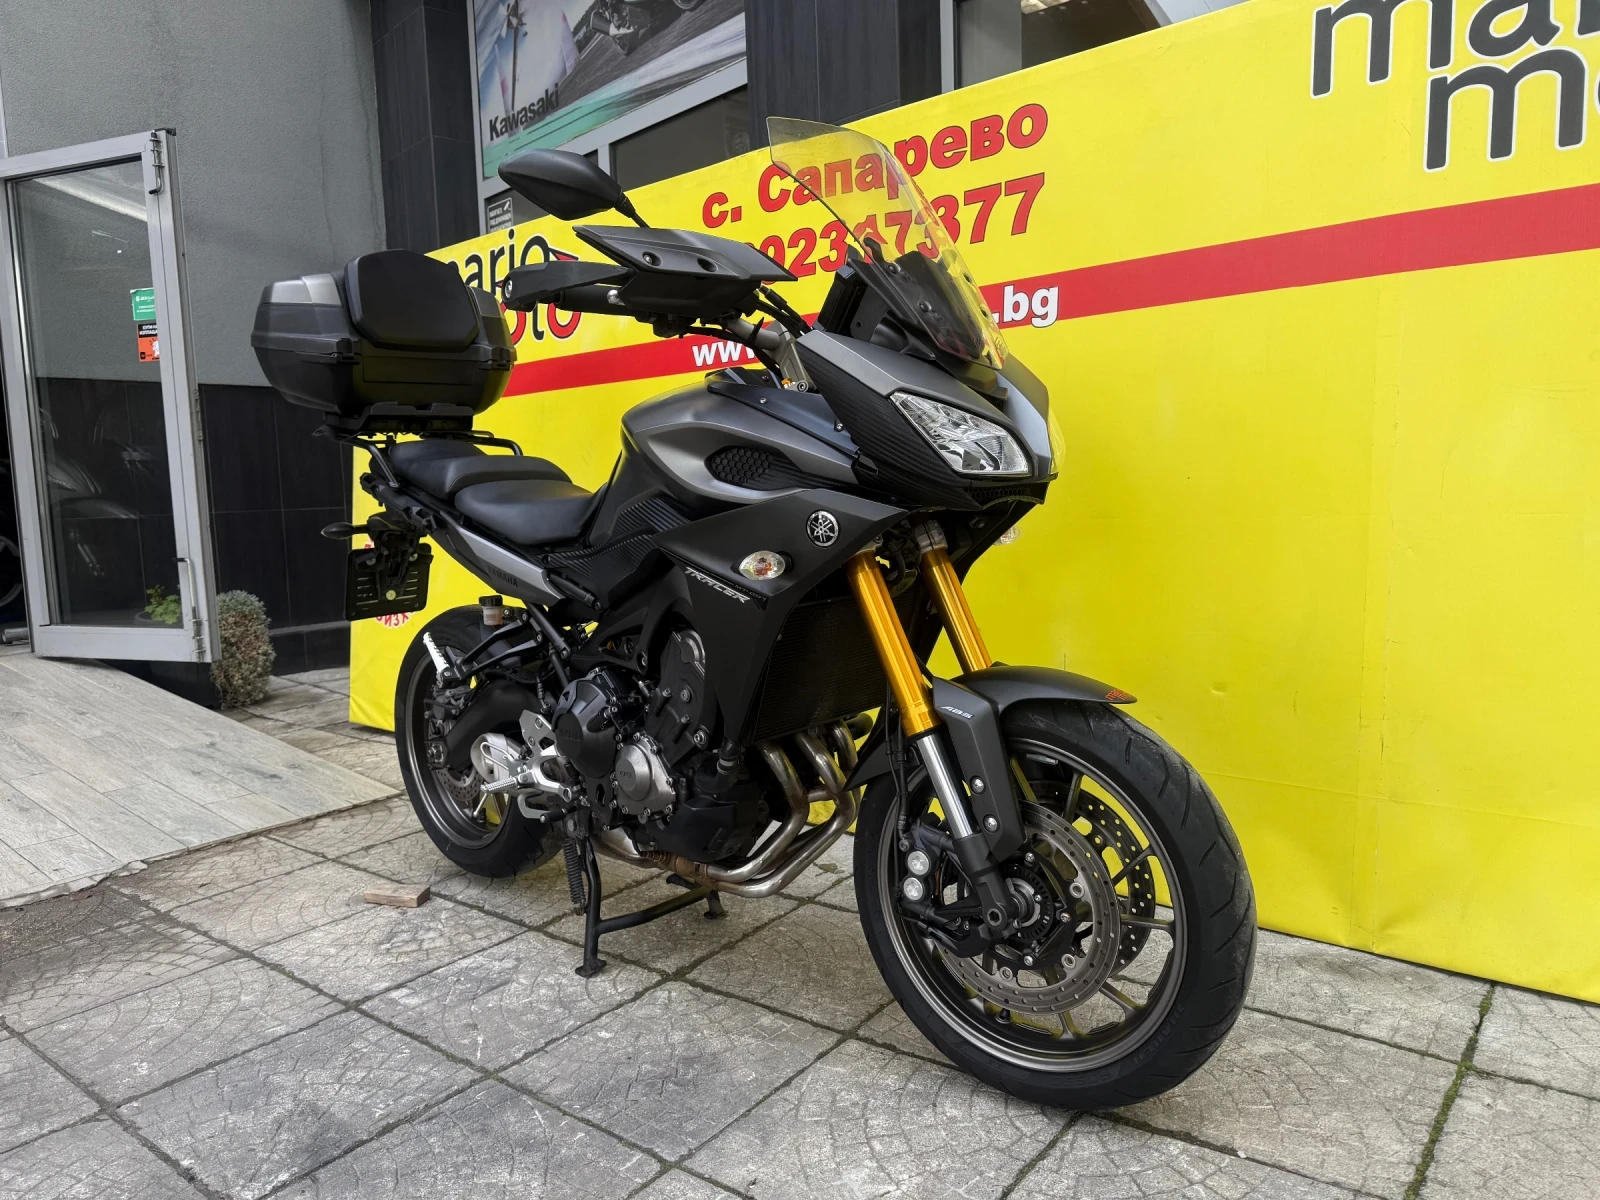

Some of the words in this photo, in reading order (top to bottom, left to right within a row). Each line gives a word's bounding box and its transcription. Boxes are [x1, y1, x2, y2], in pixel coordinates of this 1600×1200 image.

[1311, 0, 1600, 97] ma
[489, 82, 559, 142] Kawasaki
[1424, 48, 1600, 171] m
[702, 191, 743, 229] с.
[758, 103, 1048, 214] Сапарево
[487, 565, 518, 588] YAMAHA
[684, 566, 751, 603] TRACER
[941, 705, 973, 719] ABS
